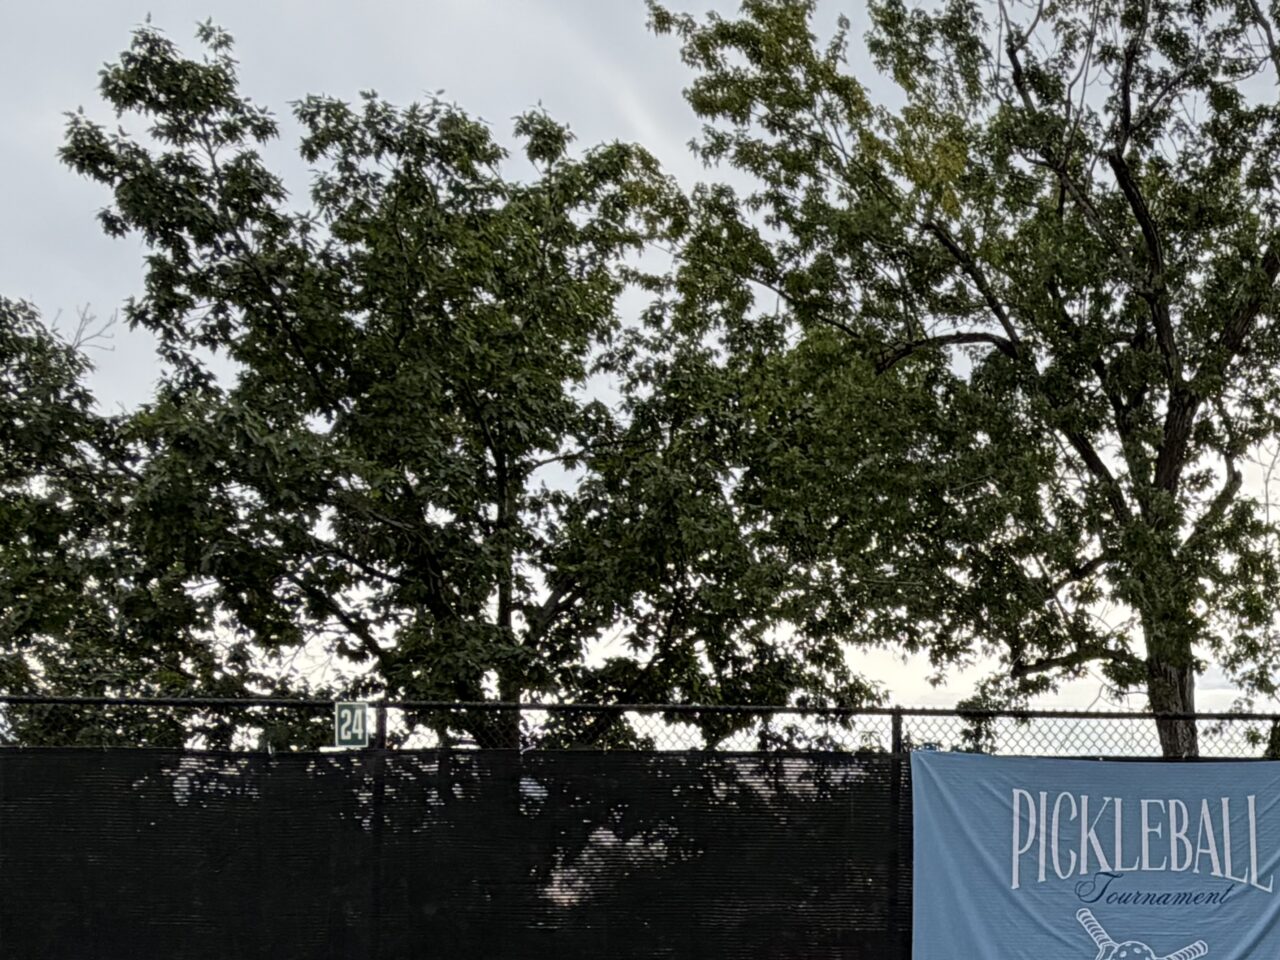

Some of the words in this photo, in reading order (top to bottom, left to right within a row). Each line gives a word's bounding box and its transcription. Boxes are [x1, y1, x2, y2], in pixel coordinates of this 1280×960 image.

[341, 708, 364, 740] 24
[1011, 788, 1274, 893] PICKLEBALL
[1074, 871, 1235, 906] Tournament
